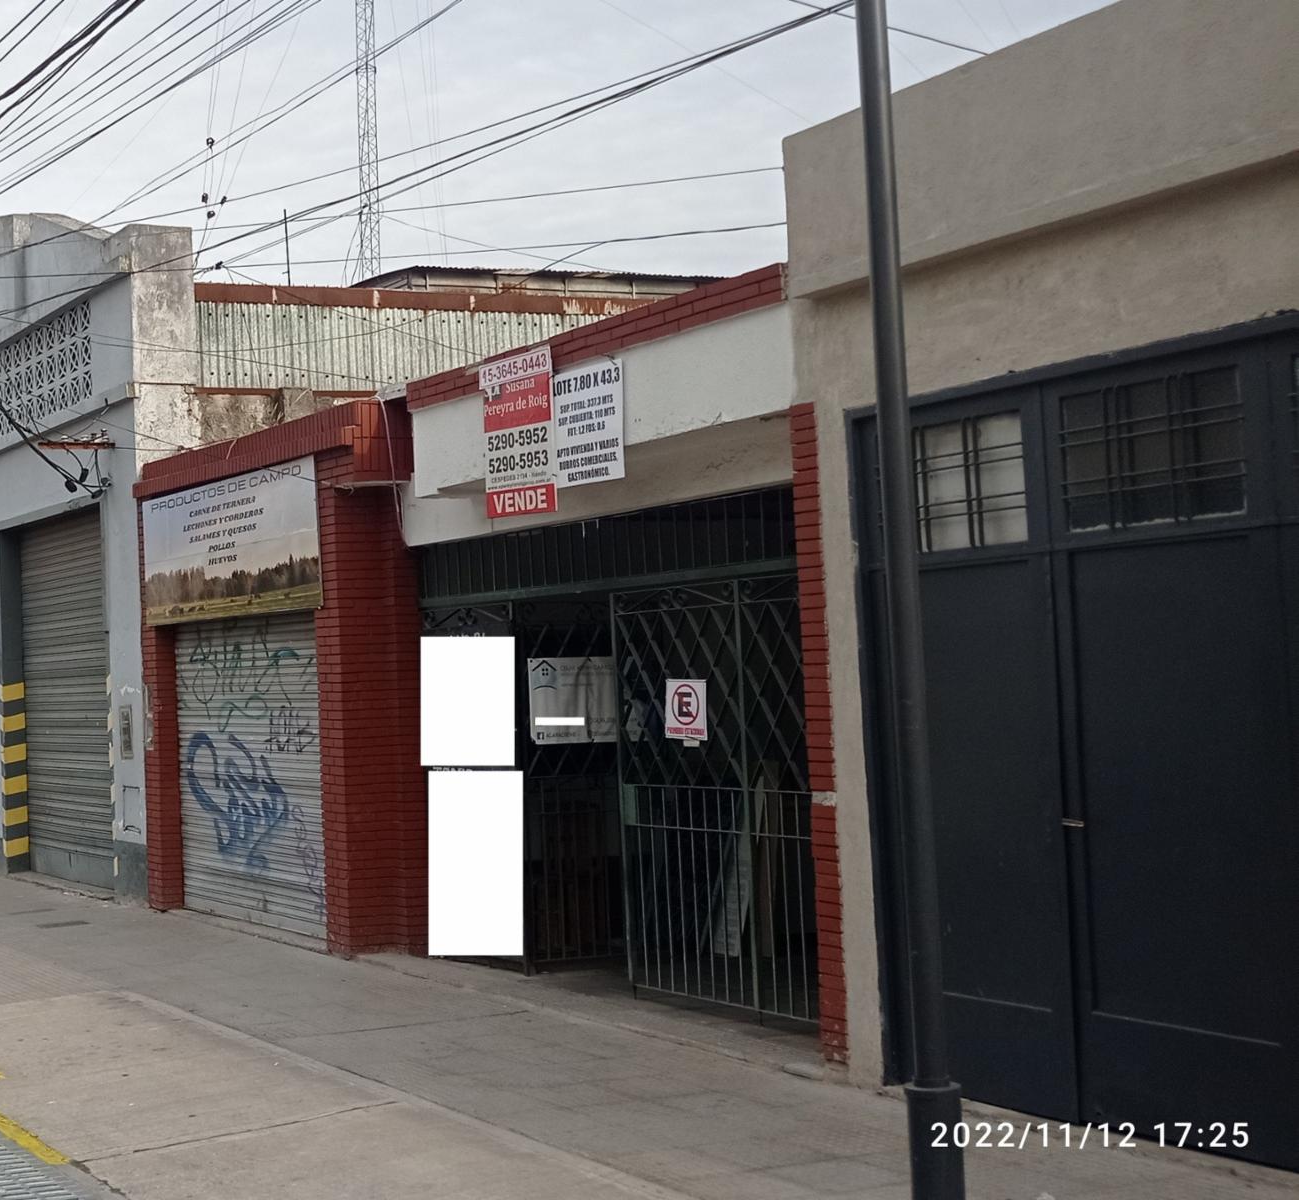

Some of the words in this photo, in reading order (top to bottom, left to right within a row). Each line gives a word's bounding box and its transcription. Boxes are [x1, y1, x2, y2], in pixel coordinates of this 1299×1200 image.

[482, 353, 548, 384] 15-3645-0443
[505, 378, 535, 394] Susana
[553, 378, 572, 397] LOTE
[573, 373, 591, 393] 7,80
[593, 371, 599, 388] X
[601, 366, 620, 385] 43,3
[484, 402, 515, 417] Pereyra
[515, 396, 527, 410] de
[528, 392, 548, 409] Roig
[594, 441, 598, 451] Y
[598, 437, 619, 451] VARIOS
[151, 484, 226, 513] PRODUCTOS
[227, 479, 247, 494] DE
[249, 464, 301, 488] CAMPO
[189, 507, 211, 518] CARNE
[211, 503, 222, 513] DE
[221, 496, 256, 511] TERNERA
[492, 487, 548, 514] VENDE
[183, 517, 218, 532] LECHONES
[218, 515, 225, 525] Y
[224, 507, 264, 523] CORDEROS
[188, 529, 221, 544] SALAMES
[221, 526, 228, 536] Y
[227, 522, 258, 538] QUESOS
[208, 541, 236, 553] POLLOS
[208, 554, 238, 566] HUEVOS
